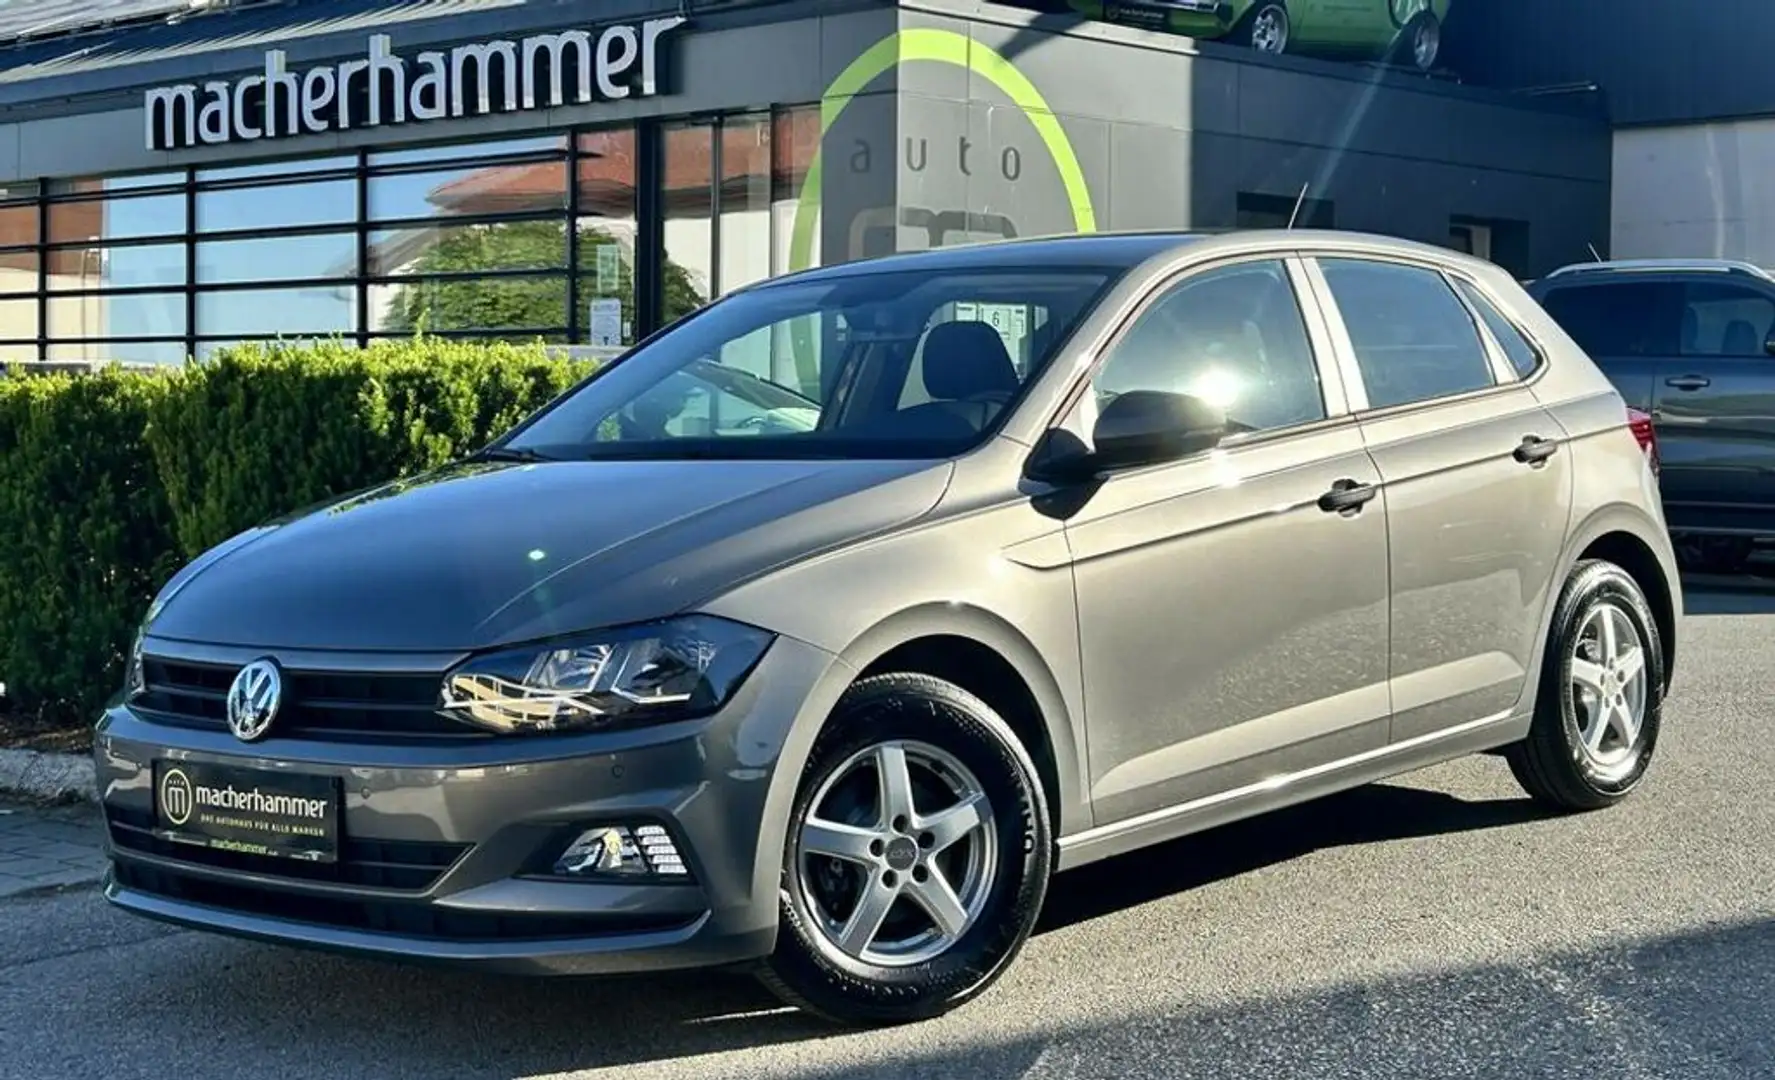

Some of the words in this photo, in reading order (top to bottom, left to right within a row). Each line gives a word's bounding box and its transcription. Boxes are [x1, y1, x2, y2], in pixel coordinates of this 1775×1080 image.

[145, 16, 687, 150] macherhammer
[850, 136, 1021, 182] auto
[195, 784, 328, 819] macherhammer
